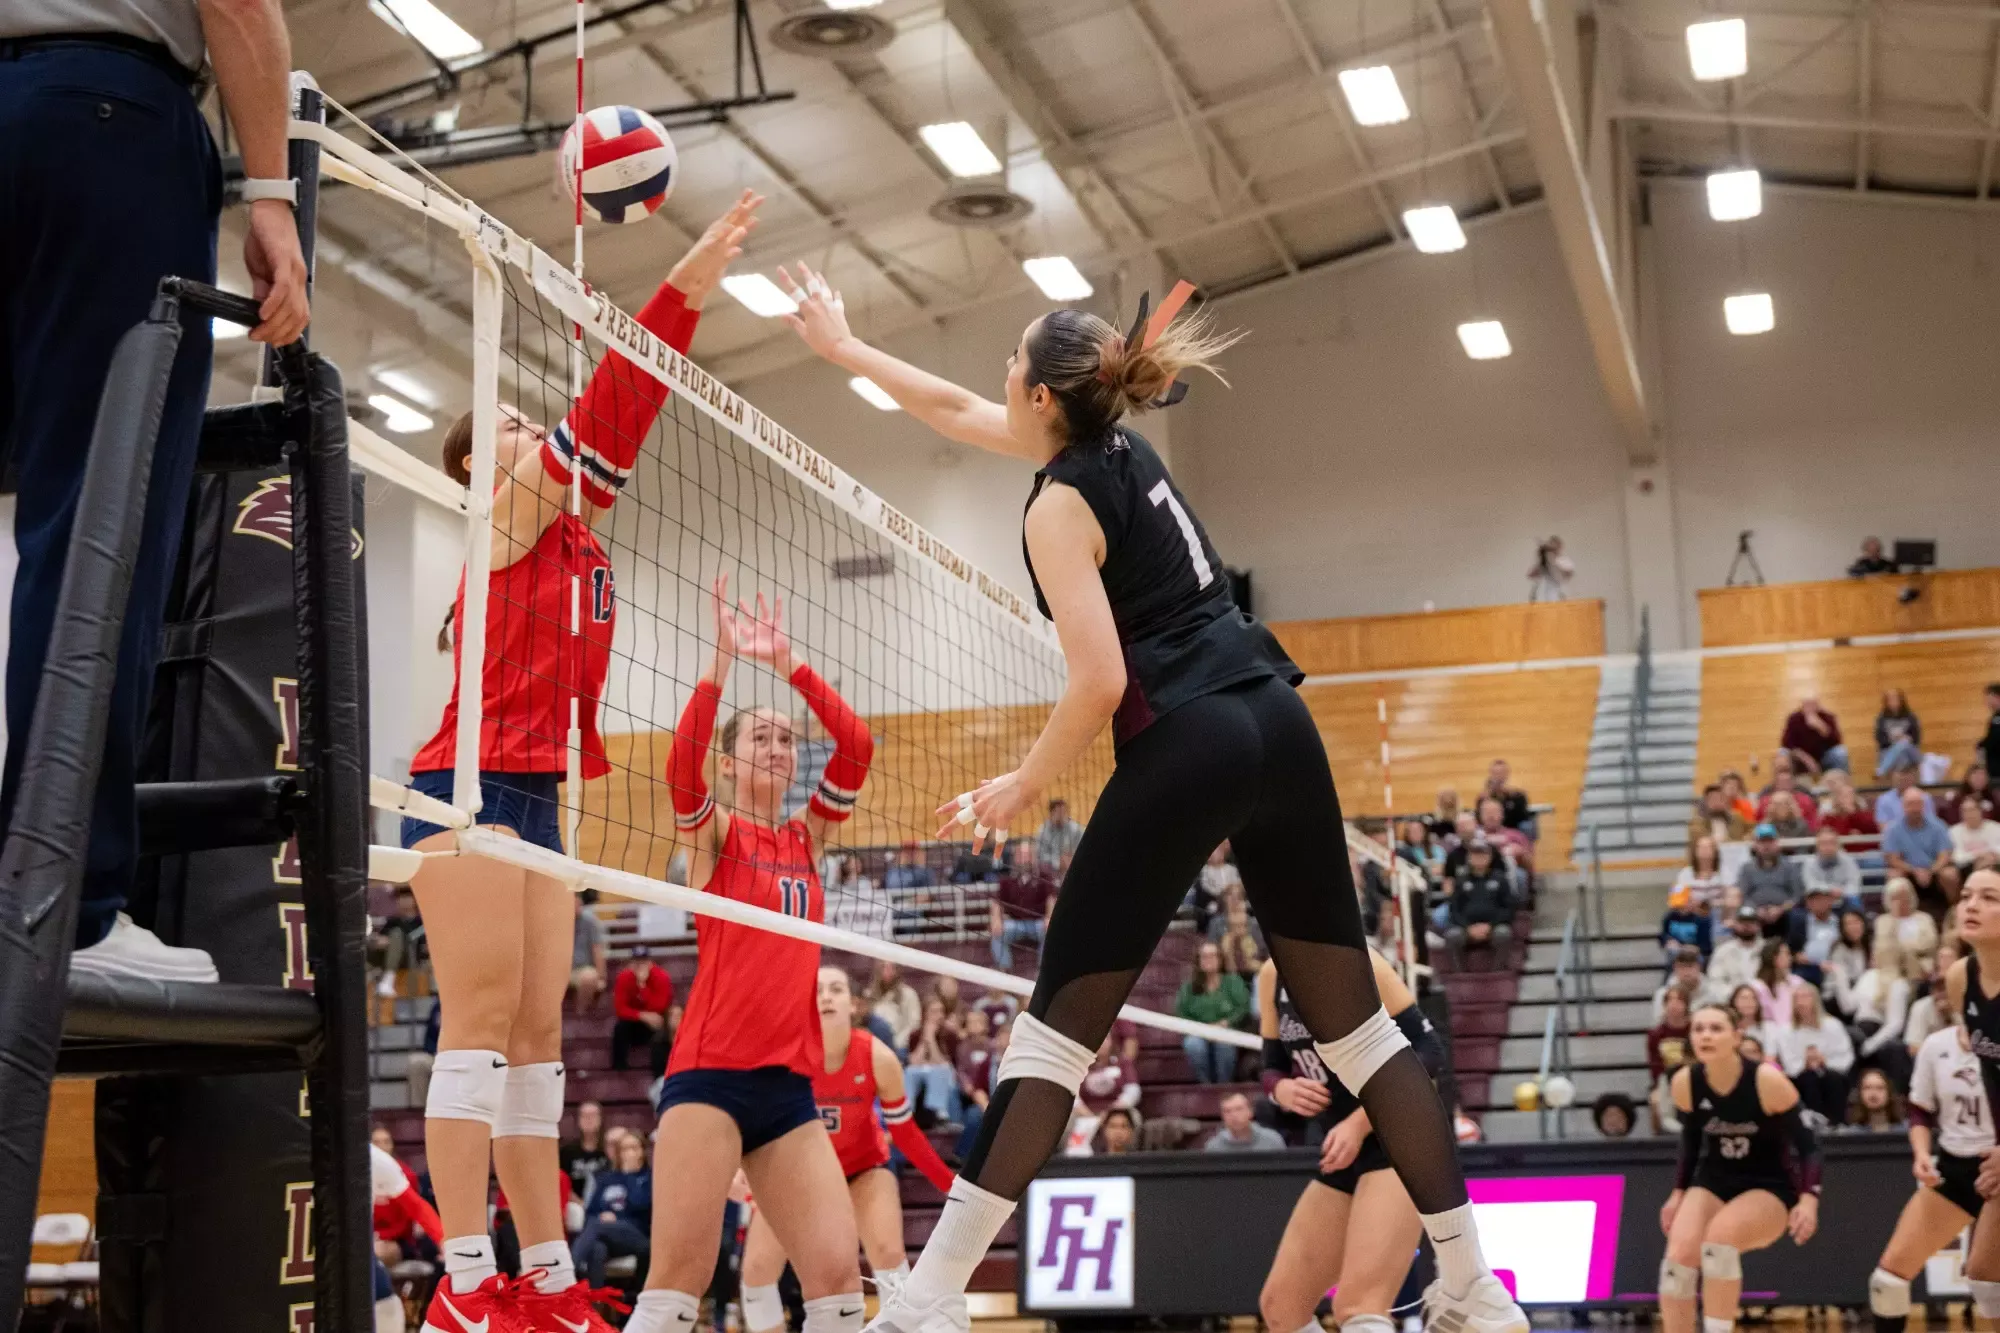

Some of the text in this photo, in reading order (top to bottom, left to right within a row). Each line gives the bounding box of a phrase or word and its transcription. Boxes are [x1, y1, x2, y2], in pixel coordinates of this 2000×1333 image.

[656, 341, 744, 425] HARDEMAN
[751, 408, 836, 490] VOLLEYBALL
[1148, 478, 1214, 591] 7
[778, 876, 809, 919] 11
[1291, 1049, 1329, 1085] 18
[1955, 1096, 1982, 1126] 24
[1037, 1194, 1123, 1291] FH
